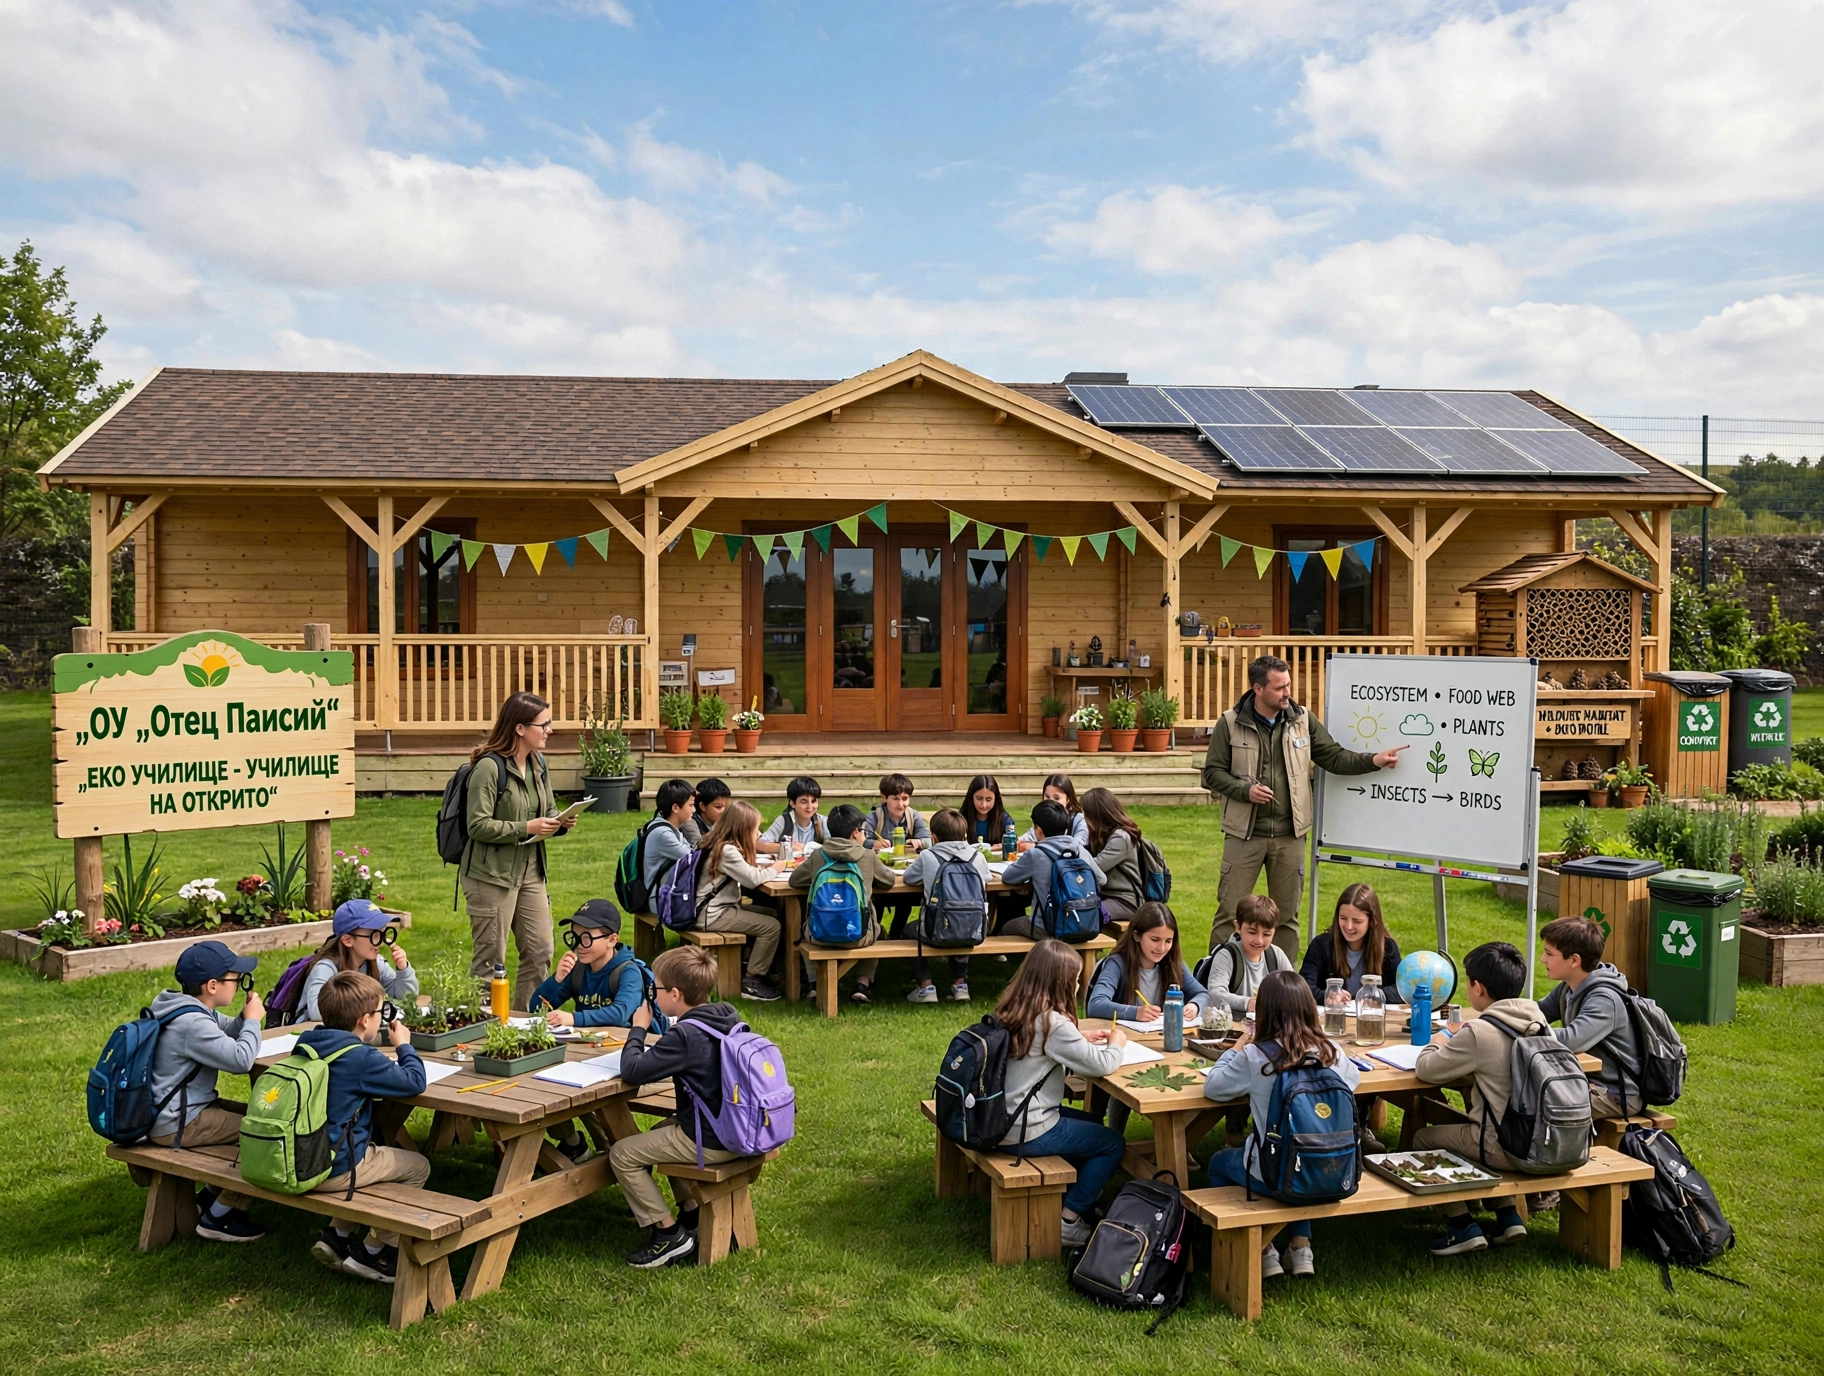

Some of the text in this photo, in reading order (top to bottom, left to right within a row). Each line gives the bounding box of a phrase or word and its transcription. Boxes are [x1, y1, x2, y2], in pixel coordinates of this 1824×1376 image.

[1351, 685, 1515, 706] ECOSYSTEM FOOD WEB
[76, 698, 339, 745] „ОУ „Отец Паисий“
[1454, 718, 1504, 736] PLANTS
[79, 766, 125, 793] „ЕКО
[131, 761, 228, 785] УЧИЛИЩЕ
[246, 755, 339, 779] УЧИЛИЩЕ
[151, 786, 277, 814] НА ОТКРИТО“
[1371, 784, 1501, 810] INSECTS BIRDS
